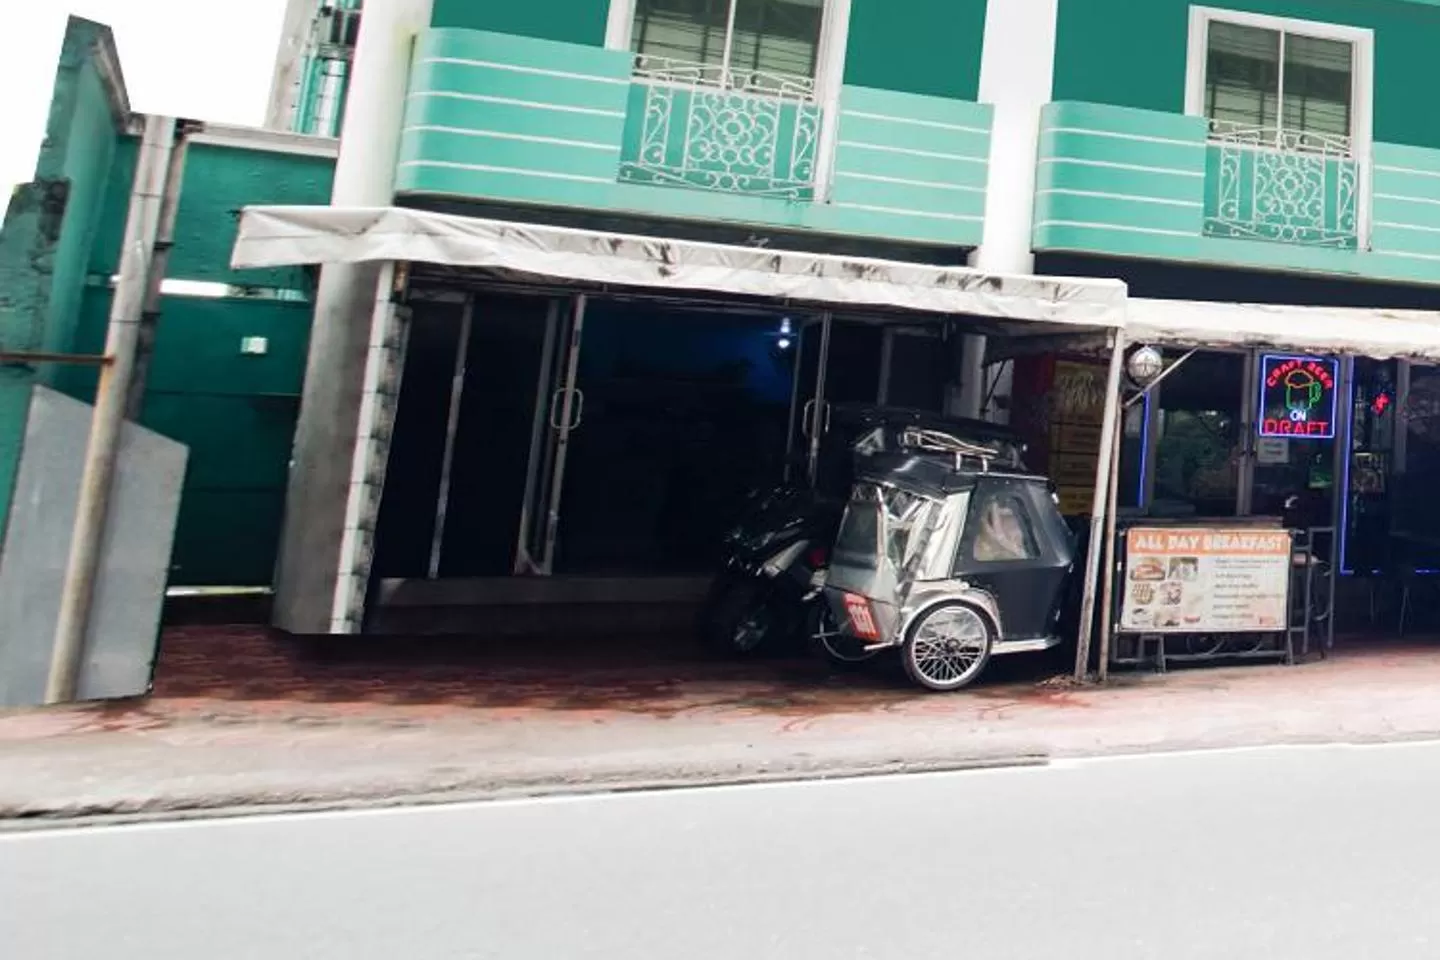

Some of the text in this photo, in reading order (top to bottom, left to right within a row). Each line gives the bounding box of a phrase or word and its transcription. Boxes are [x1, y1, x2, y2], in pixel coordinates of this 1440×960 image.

[1266, 359, 1333, 388] CRAFT BEER
[1289, 409, 1307, 421] ON
[1264, 419, 1329, 436] DRAFT
[1135, 531, 1282, 552] ALL DAY BREAKFAST
